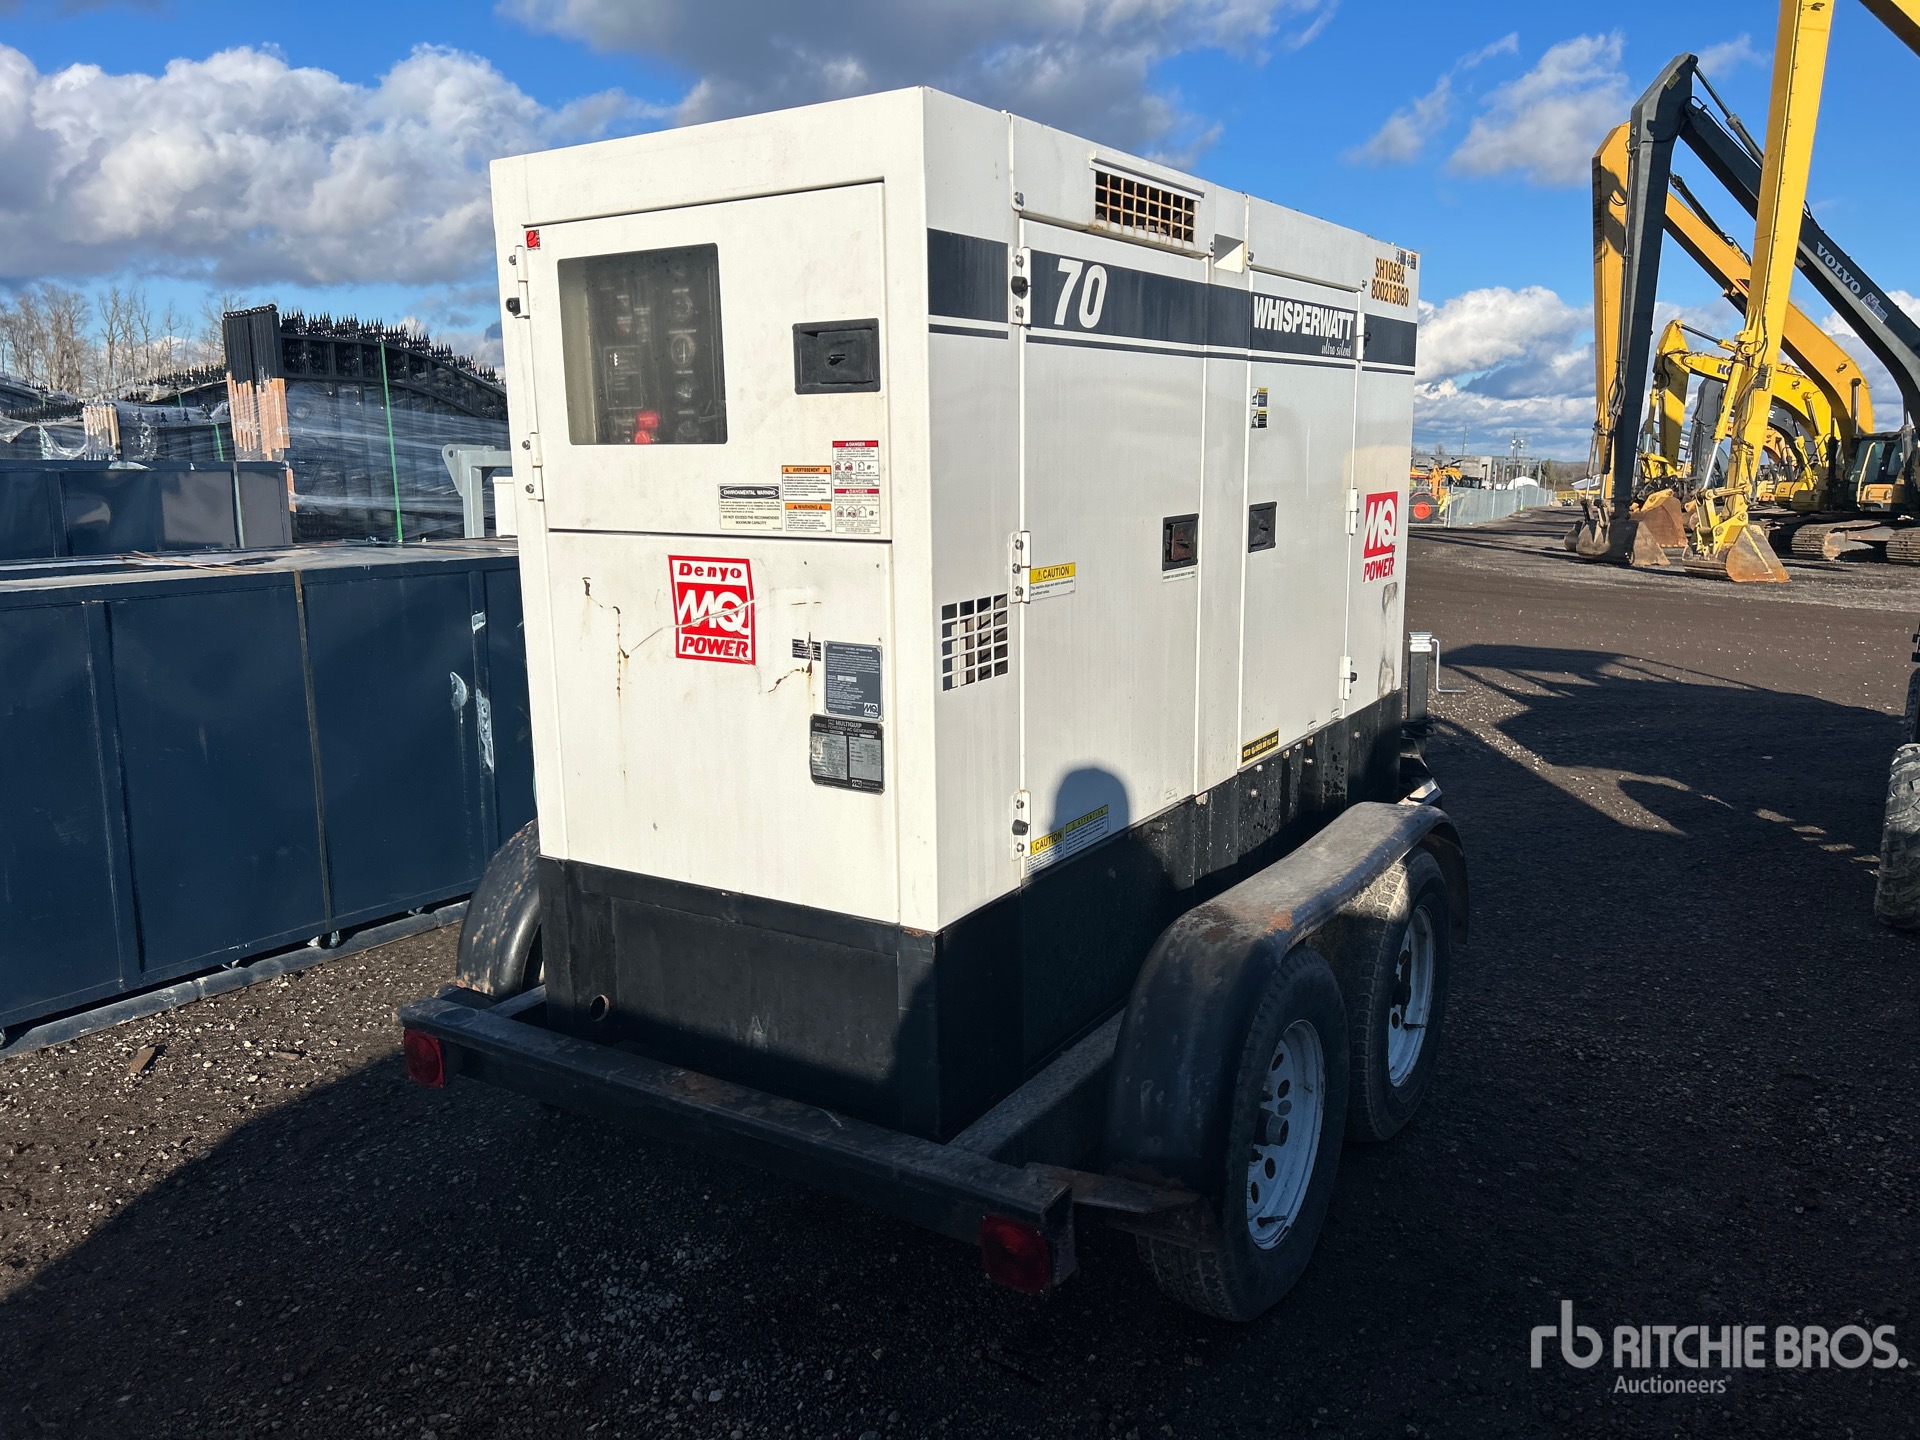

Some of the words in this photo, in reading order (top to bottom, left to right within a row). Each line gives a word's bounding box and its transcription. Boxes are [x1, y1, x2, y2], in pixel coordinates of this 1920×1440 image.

[1375, 258, 1405, 284] SH10586
[1816, 242, 1861, 294] VOLVO
[1054, 258, 1108, 328] 70
[1372, 279, 1409, 307] 800213080
[1254, 296, 1354, 340] WHISPERWATT
[1321, 337, 1336, 356] ultra
[1336, 340, 1352, 357] silent
[1364, 498, 1396, 549] MQ
[679, 563, 742, 582] Denyo
[1043, 566, 1069, 578] CAUTION
[1363, 557, 1394, 582] POWER
[678, 589, 748, 636] MQ
[682, 636, 748, 657] POWER
[1036, 831, 1062, 851] CAUTION
